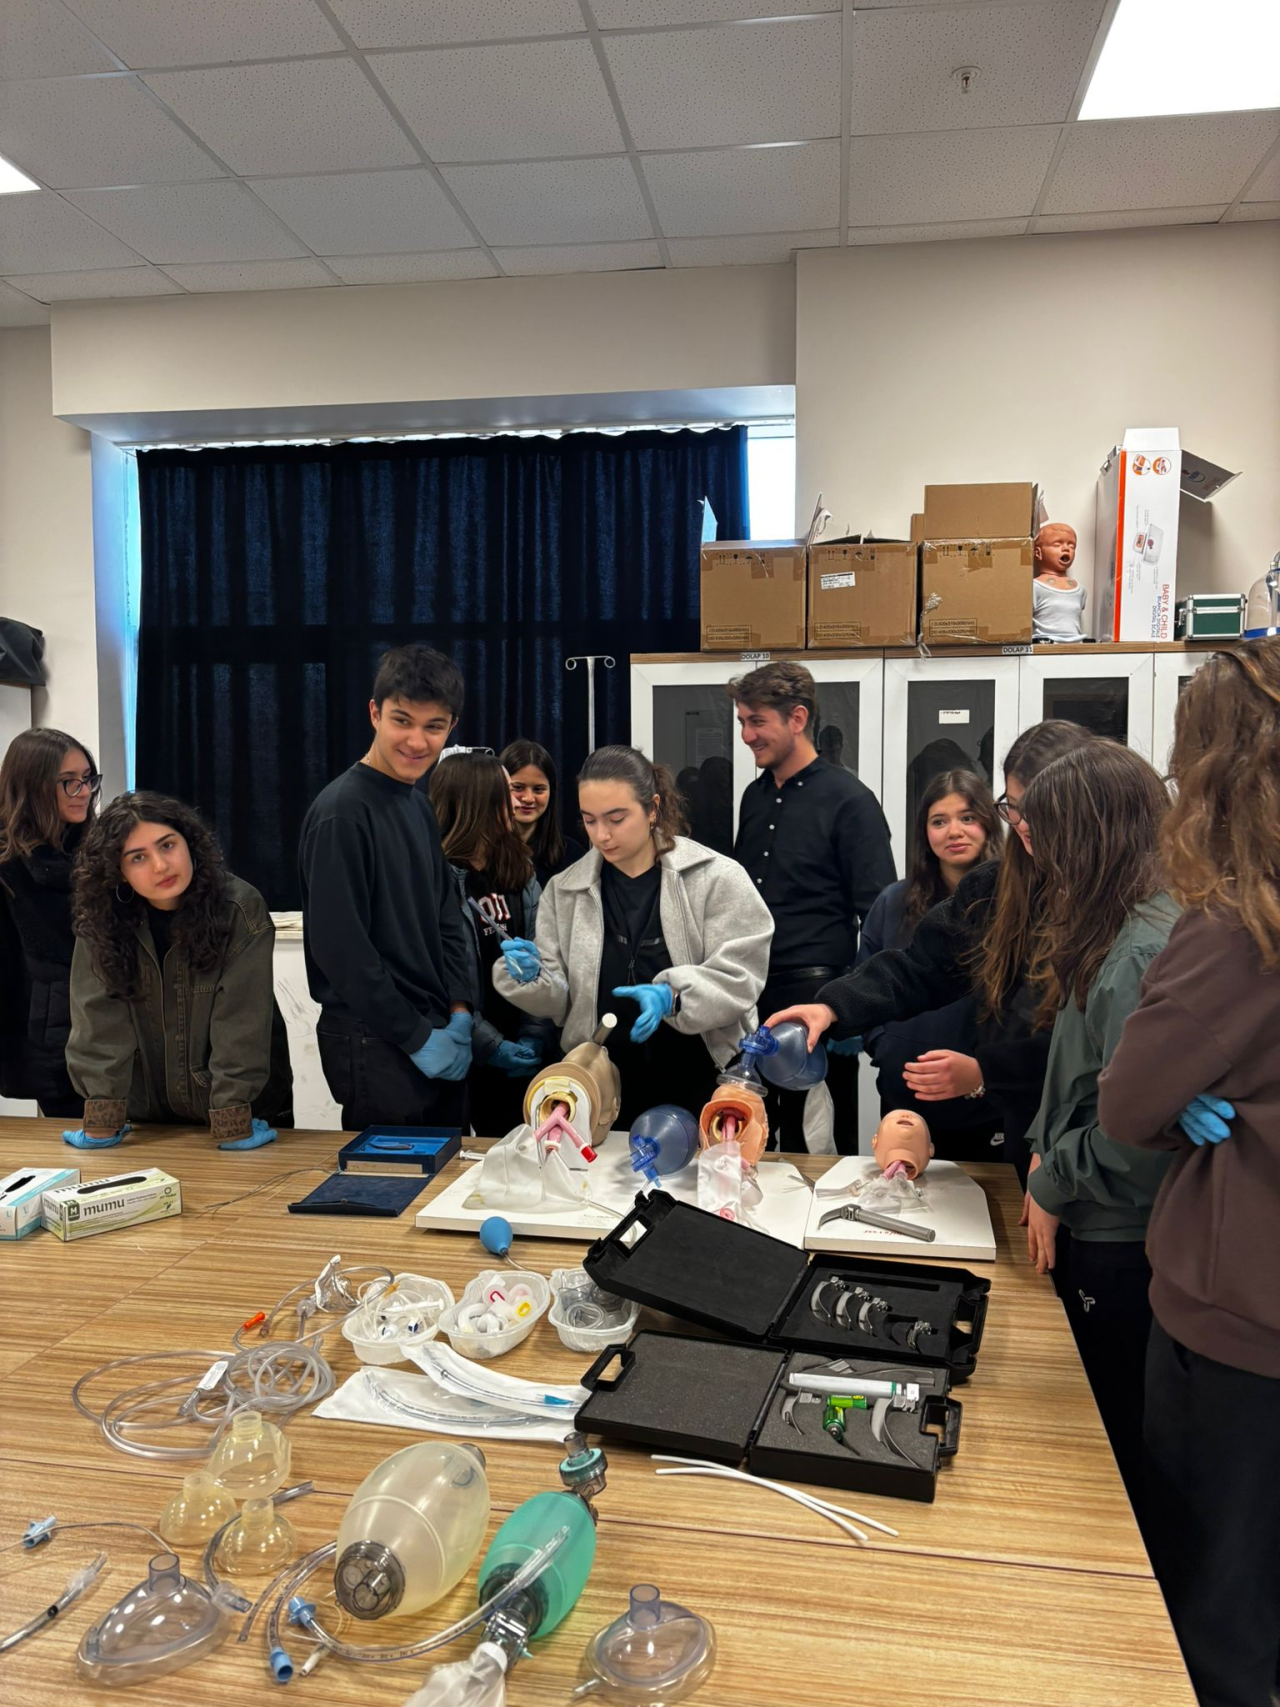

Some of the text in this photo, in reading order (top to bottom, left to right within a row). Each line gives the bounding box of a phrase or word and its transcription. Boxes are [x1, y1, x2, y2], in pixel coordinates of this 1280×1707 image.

[1162, 584, 1170, 605] BABY
[1160, 614, 1169, 639] CHILD
[83, 1198, 125, 1217] mumu
